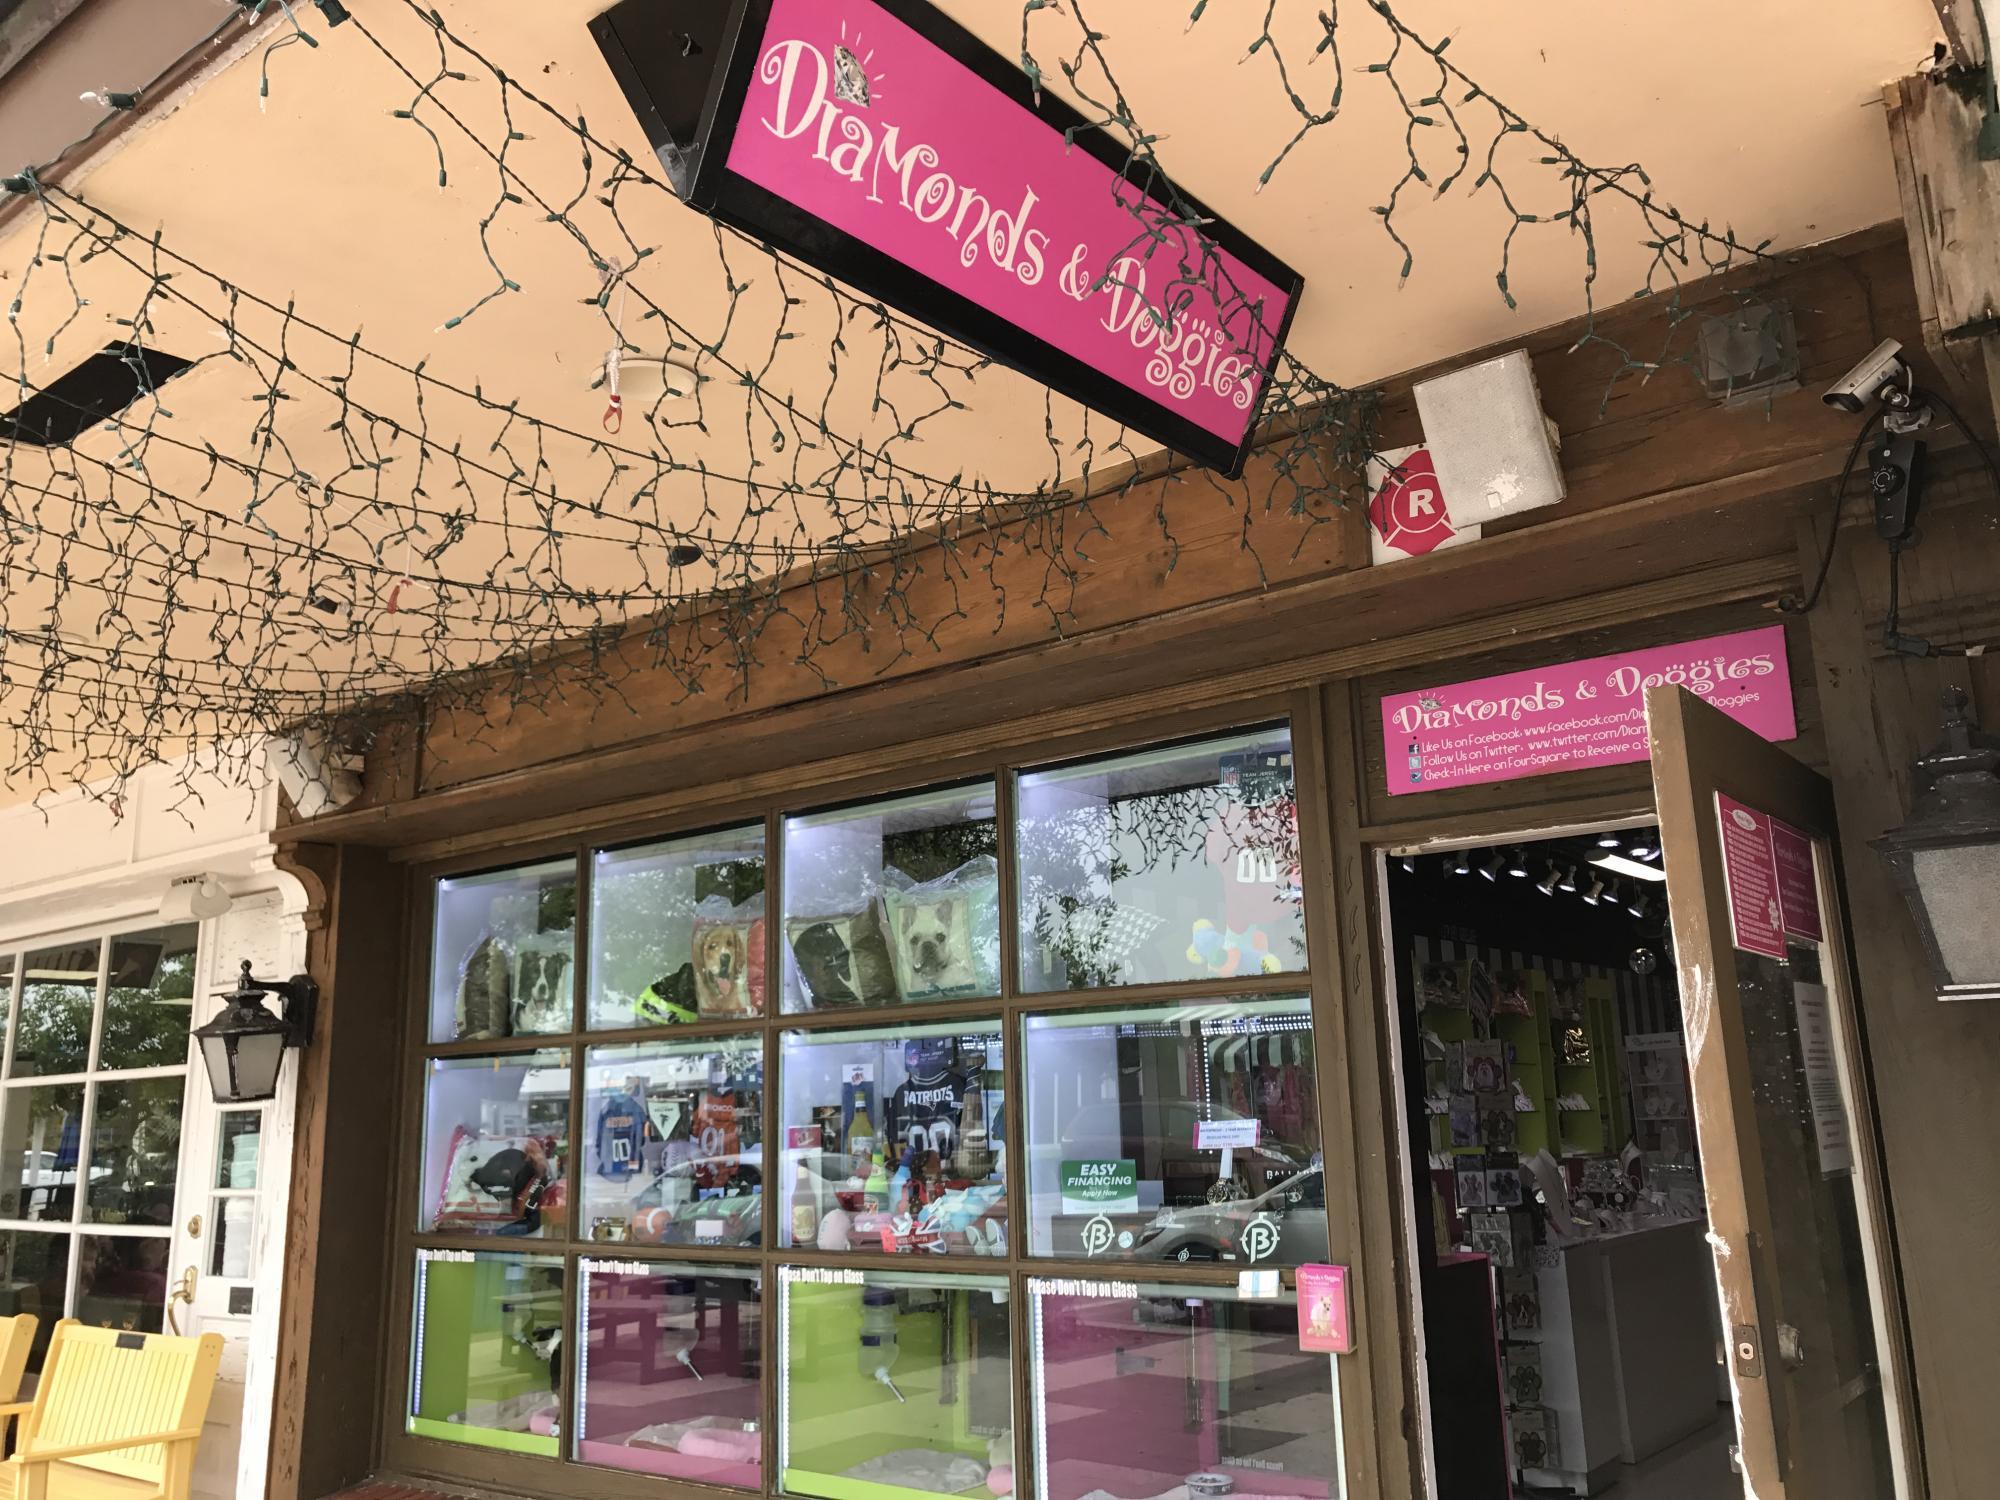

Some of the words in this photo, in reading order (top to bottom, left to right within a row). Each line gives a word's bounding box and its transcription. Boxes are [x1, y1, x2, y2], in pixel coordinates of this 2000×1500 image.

[1059, 243, 1094, 301] &
[1409, 488, 1435, 517] R
[1575, 679, 1598, 700] &
[1422, 753, 1454, 767] Follow
[1455, 750, 1467, 762] Us
[1468, 749, 1481, 760] on
[1527, 723, 1649, 751] www.twitter.com/Diam
[1422, 741, 1440, 754] Like
[1441, 738, 1453, 750] Us
[1454, 738, 1468, 748] on
[1465, 762, 1492, 774] Here
[1493, 760, 1506, 771] on
[1507, 750, 1570, 770] FourSquare
[1572, 747, 1587, 759] to
[1587, 742, 1630, 757] Receive
[1632, 741, 1642, 751] a
[904, 1085, 954, 1107] PATRIOTS
[1080, 1163, 1117, 1176] EASY
[1067, 1176, 1132, 1187] FINANCING
[1082, 1190, 1102, 1198] Apply
[820, 1267, 833, 1285] Tap
[844, 1268, 864, 1285] Glass
[1057, 1278, 1081, 1296] Don't
[1081, 1279, 1098, 1299] Tap
[1099, 1282, 1111, 1297] on
[1112, 1280, 1138, 1299] Glass
